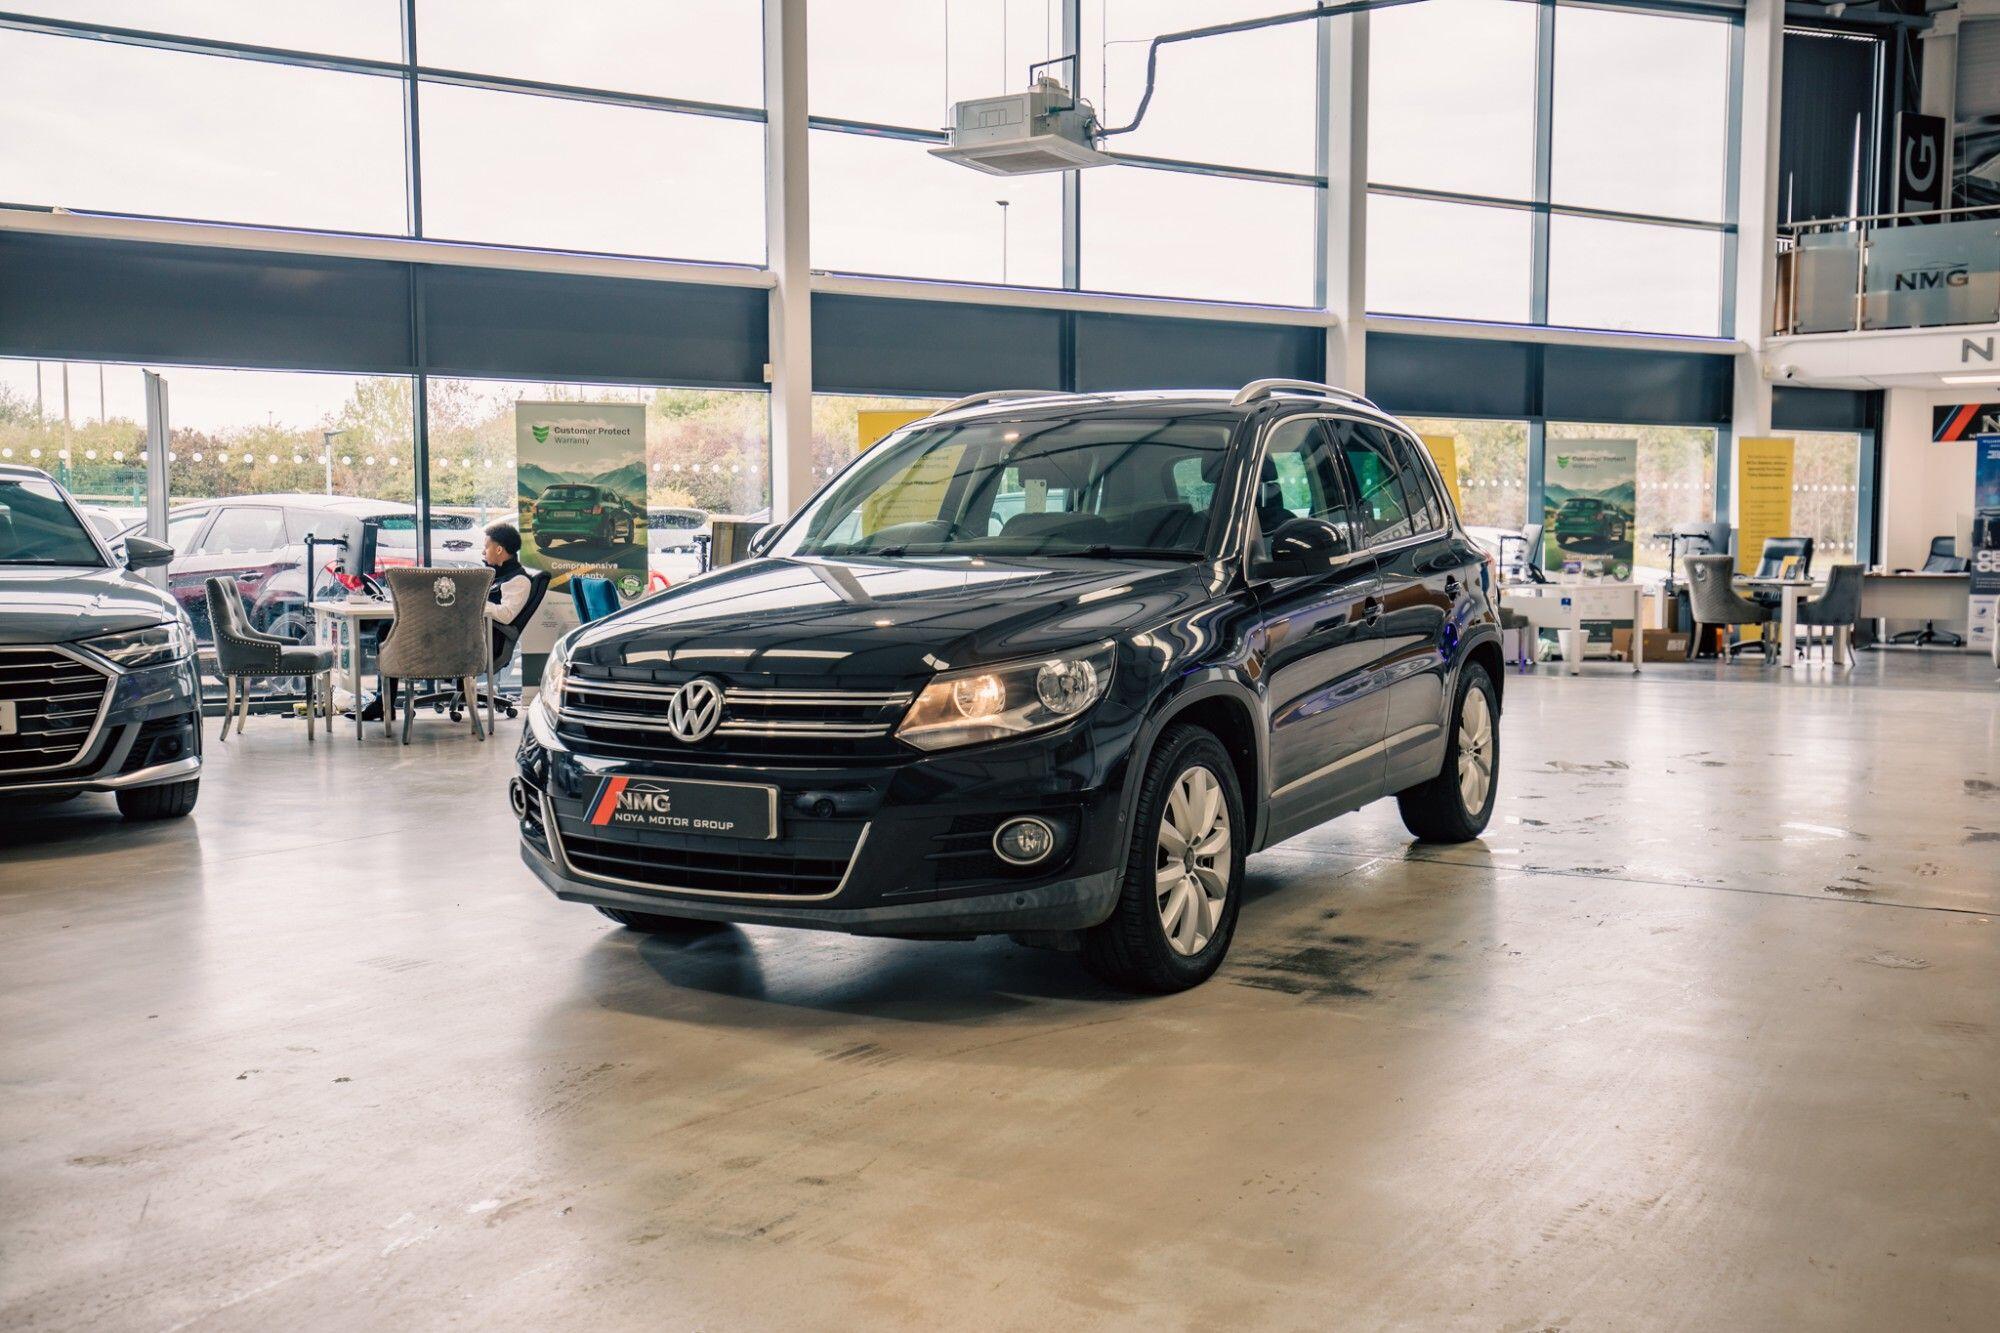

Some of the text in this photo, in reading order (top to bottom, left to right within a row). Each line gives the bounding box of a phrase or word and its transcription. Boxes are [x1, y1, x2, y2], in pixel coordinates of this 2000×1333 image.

[1894, 269, 1969, 291] NMG
[554, 426, 631, 435] Customer Protect
[554, 437, 590, 445] Warranty
[551, 561, 618, 570] Comprehensive
[616, 791, 671, 813] NMG
[615, 813, 734, 830] NOYA MOTOR GROUP
